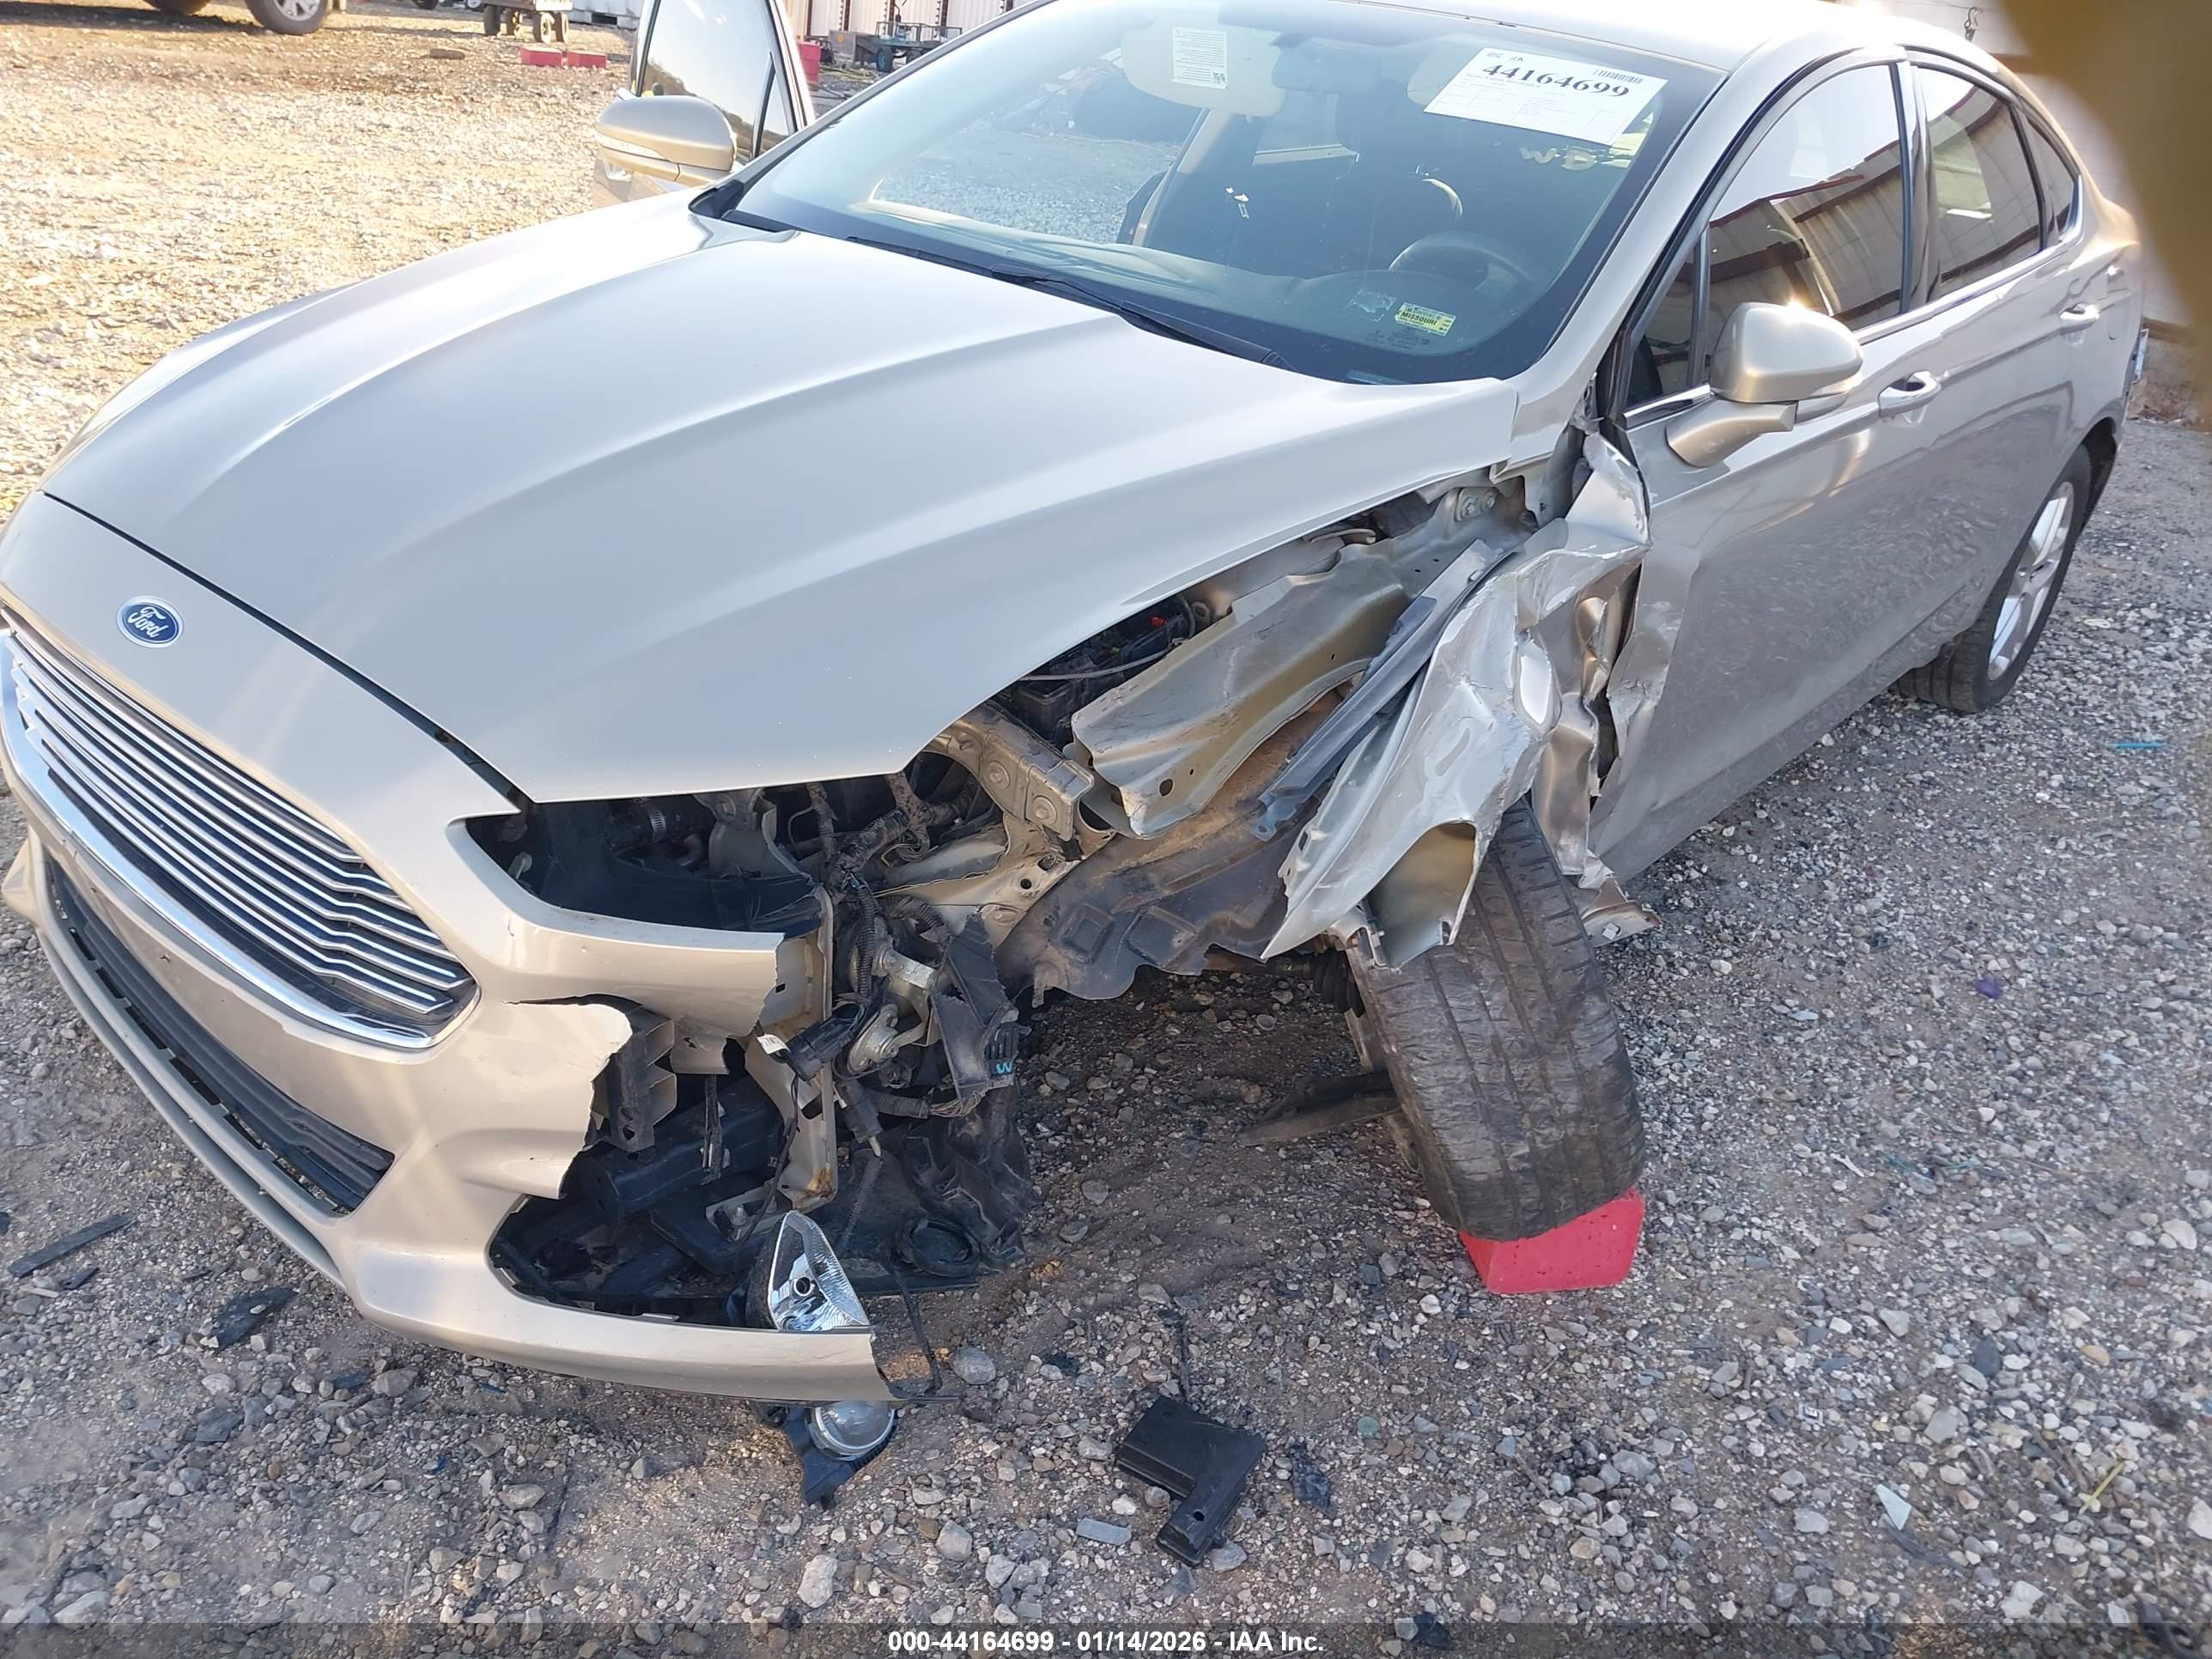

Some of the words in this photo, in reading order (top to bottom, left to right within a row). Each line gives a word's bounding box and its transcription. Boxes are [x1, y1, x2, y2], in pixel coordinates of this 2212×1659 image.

[1483, 64, 1630, 97] 44164699
[1401, 312, 1437, 326] MISSOURI
[128, 606, 169, 638] Ford
